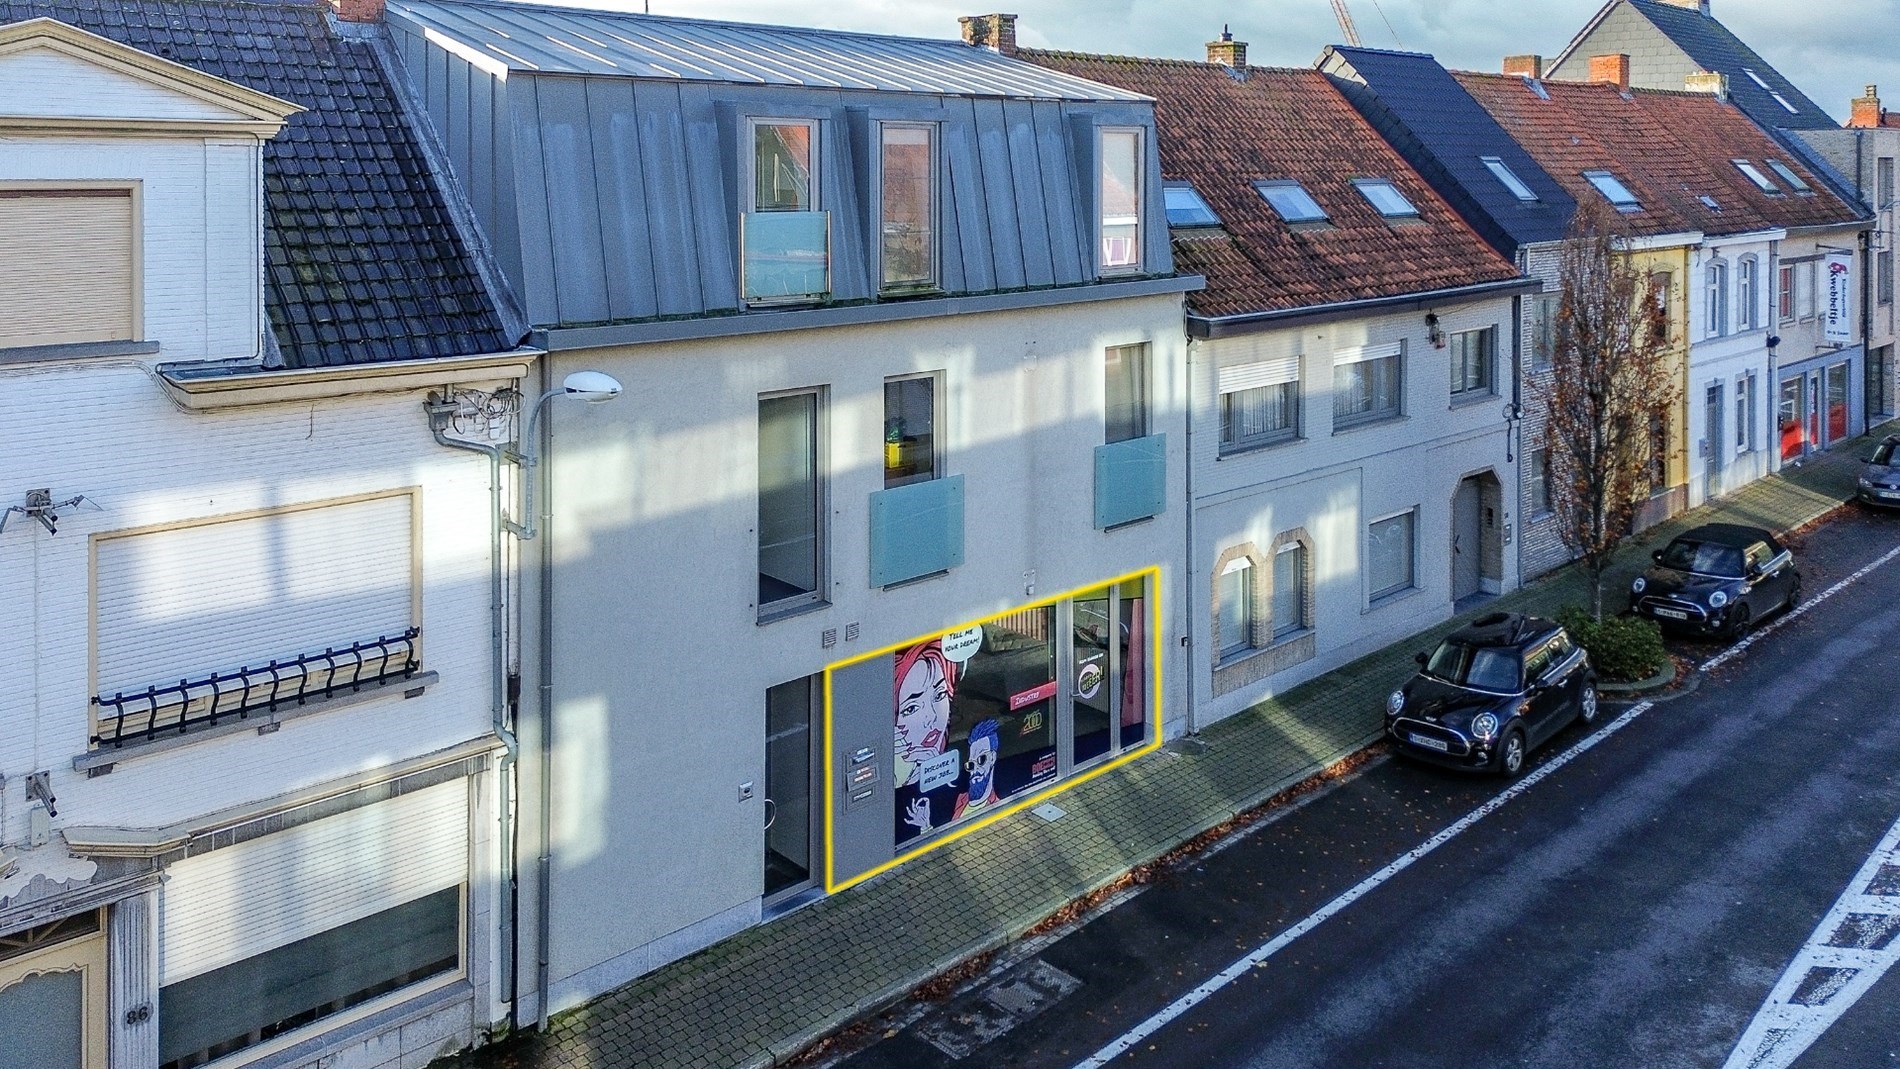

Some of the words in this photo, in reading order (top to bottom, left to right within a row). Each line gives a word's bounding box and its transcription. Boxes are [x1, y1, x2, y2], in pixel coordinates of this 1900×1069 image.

[1828, 269, 1839, 325] Kwebbeltje
[949, 632, 963, 640] TELL
[964, 628, 973, 637] ME
[945, 643, 959, 652] YOUR
[960, 636, 980, 648] DREAM!
[924, 760, 949, 774] DISCOVER
[924, 775, 937, 784] NEW
[127, 1006, 148, 1025] 86
